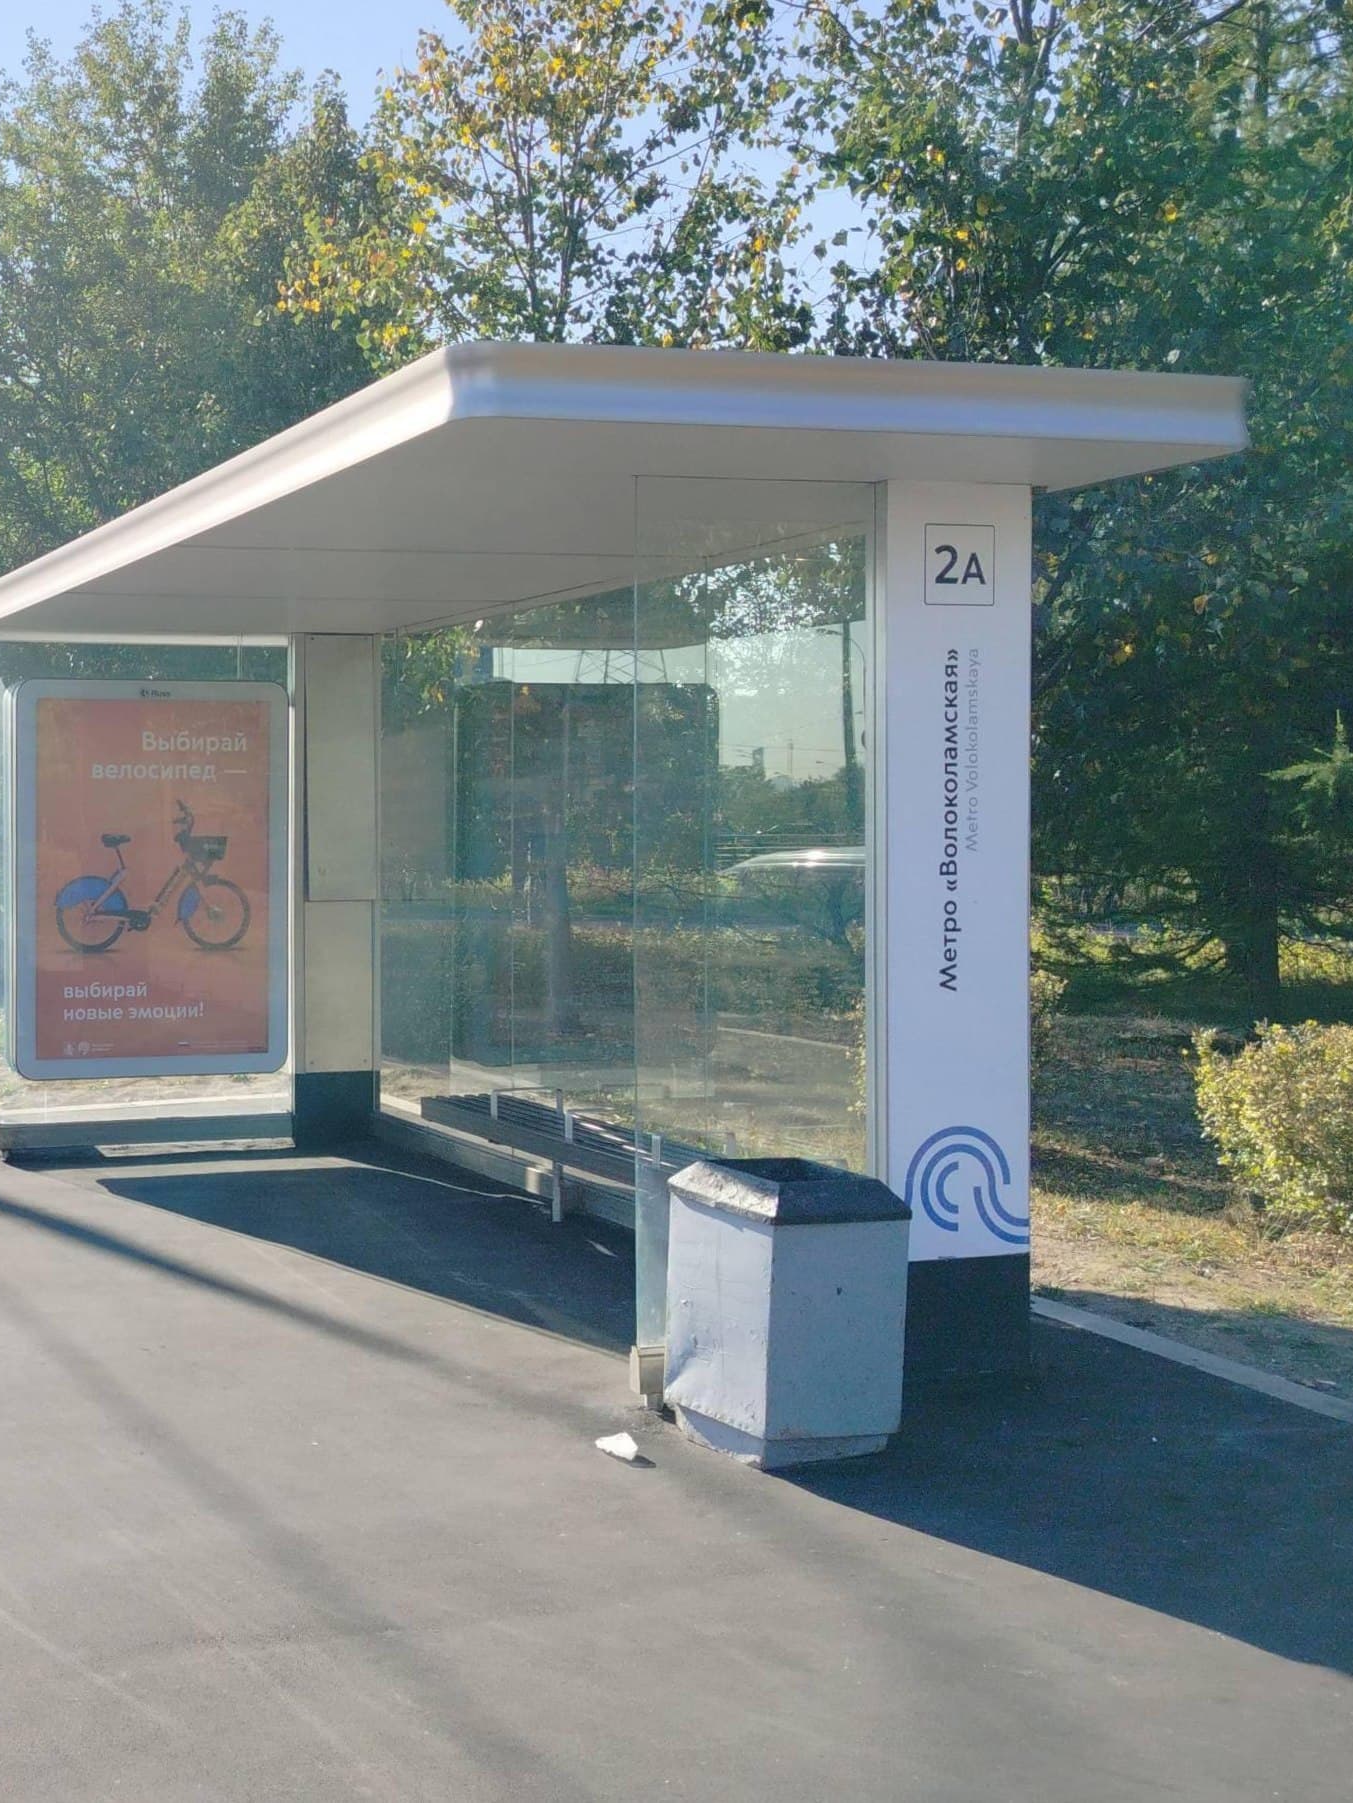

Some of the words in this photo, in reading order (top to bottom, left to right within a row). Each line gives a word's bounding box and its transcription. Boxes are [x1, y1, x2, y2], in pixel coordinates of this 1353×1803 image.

[965, 648, 981, 792] Volokolamskaya
[141, 730, 248, 755] Выбирай
[91, 763, 217, 782] велосипед
[939, 648, 959, 892] «Волоколамская»
[965, 795, 979, 852] Metro
[939, 899, 962, 992] Метро
[63, 981, 148, 1001] выбирай
[63, 1006, 124, 1021] новые
[128, 1000, 205, 1020] эмоции!
